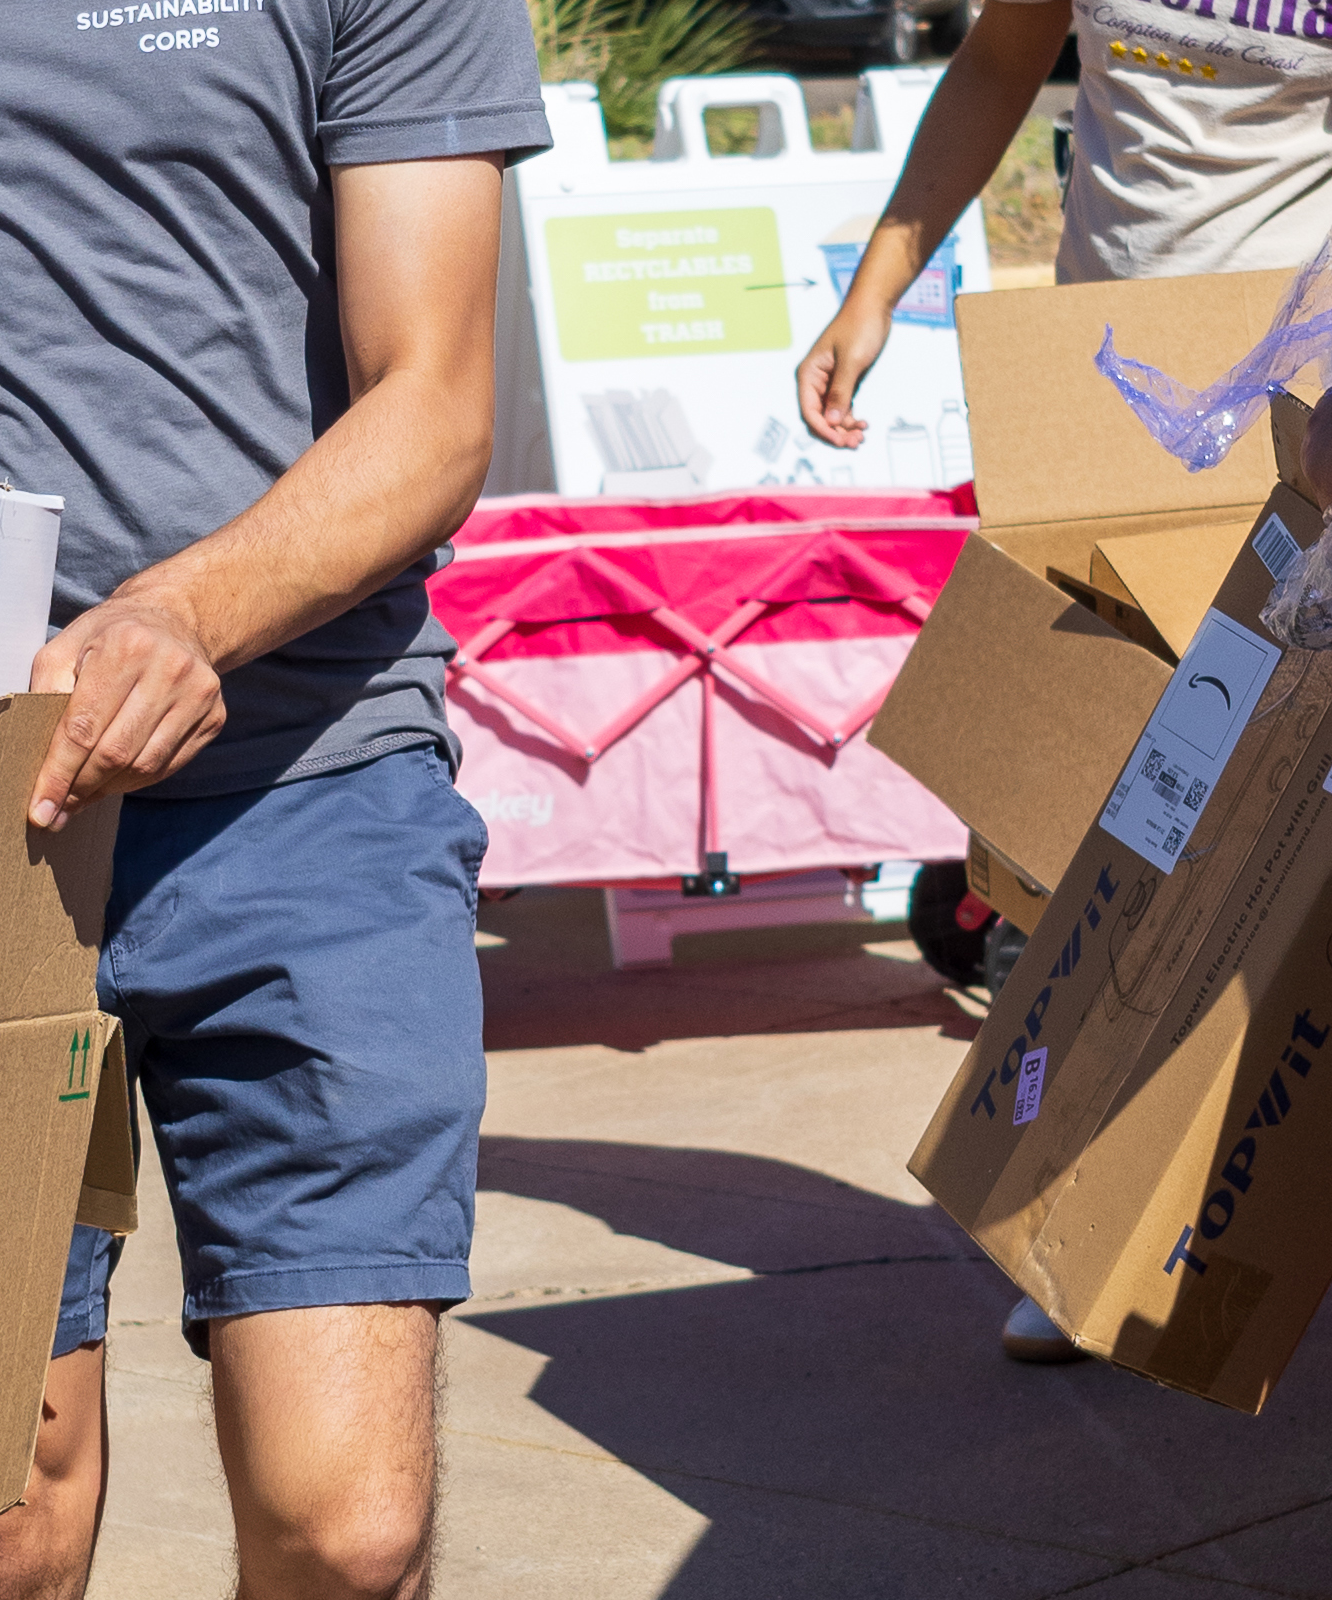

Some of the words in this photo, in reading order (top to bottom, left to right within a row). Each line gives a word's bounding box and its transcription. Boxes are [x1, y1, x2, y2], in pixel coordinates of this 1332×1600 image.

[139, 28, 220, 52] CORPS
[1241, 45, 1303, 70] Coast
[616, 226, 719, 250] Separate
[582, 255, 753, 282] RECYCLABLES
[648, 291, 705, 311] from
[641, 319, 724, 343] TRASH
[1168, 982, 1214, 1048] Topwit
[1201, 909, 1253, 985] Electric
[1242, 874, 1270, 910] Hot
[1262, 838, 1290, 874] Pot
[1280, 796, 1311, 839] with
